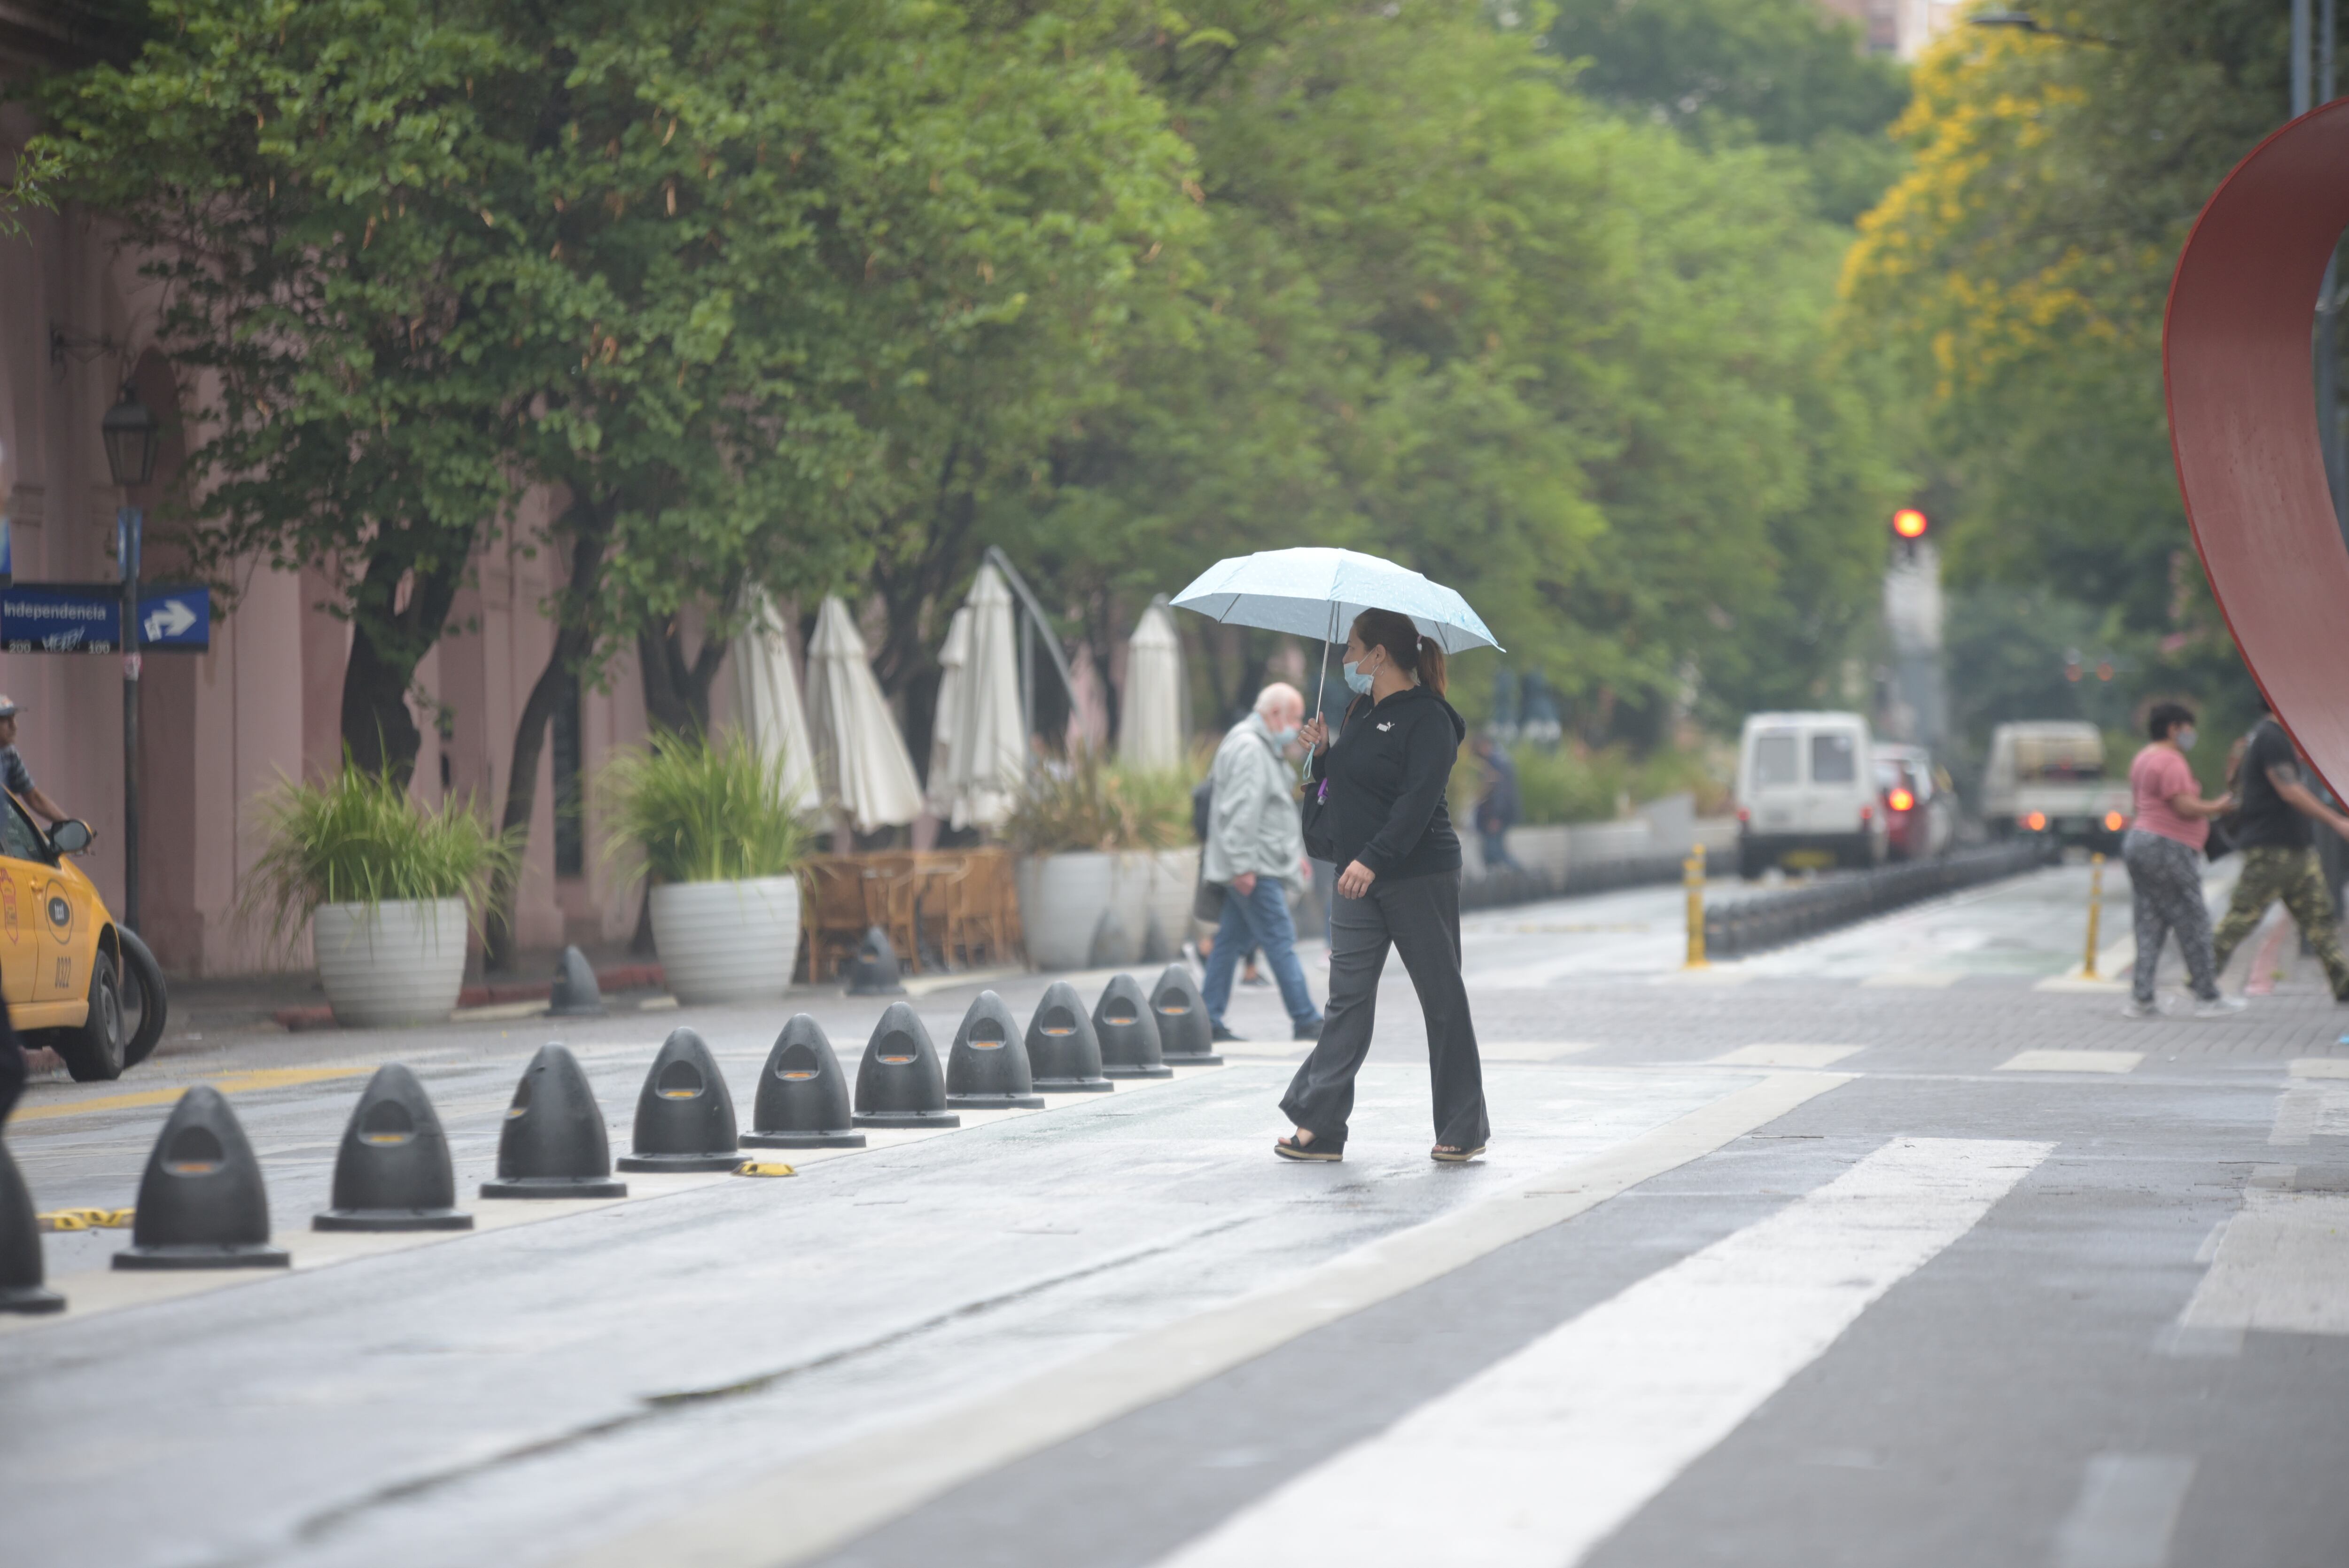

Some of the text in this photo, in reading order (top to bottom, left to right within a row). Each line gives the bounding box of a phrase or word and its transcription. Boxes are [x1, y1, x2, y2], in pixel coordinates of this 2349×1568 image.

[4, 600, 106, 621] Independencia
[9, 639, 110, 654] 200 100
[54, 903, 64, 921] taxi
[55, 956, 71, 988] 0322
